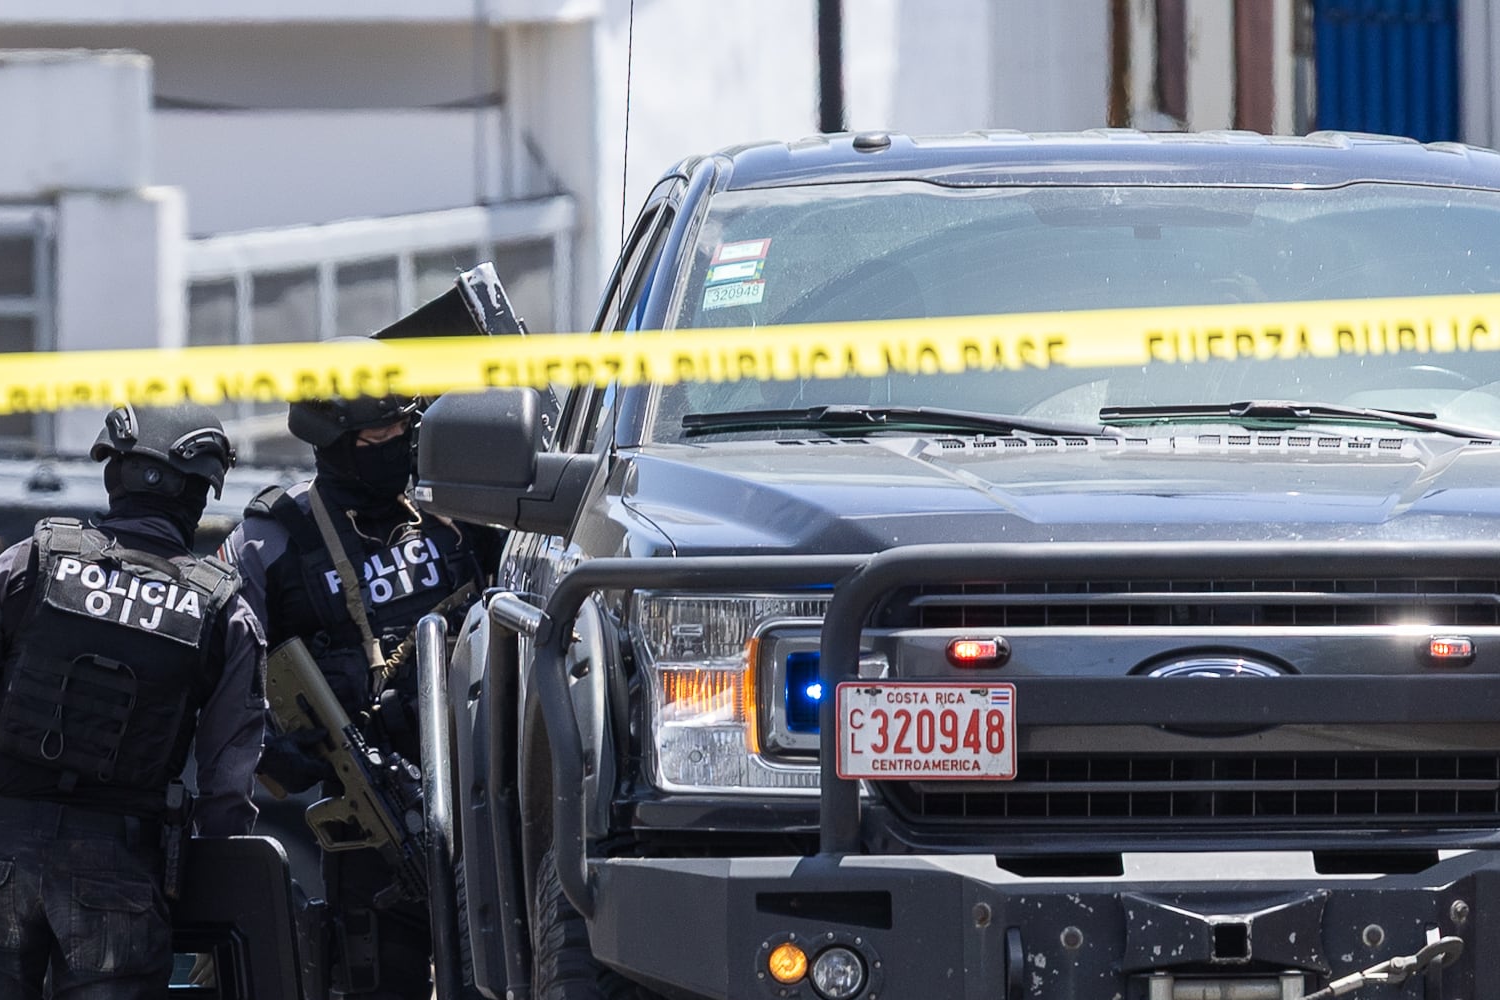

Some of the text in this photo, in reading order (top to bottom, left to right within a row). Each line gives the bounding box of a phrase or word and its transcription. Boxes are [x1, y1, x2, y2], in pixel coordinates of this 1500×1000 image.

[711, 284, 760, 302] 320948
[55, 557, 200, 618] POLICIA
[886, 692, 965, 704] COSTA RICA
[870, 708, 1005, 754] 320948
[871, 759, 981, 771] CENTROAMERICA
